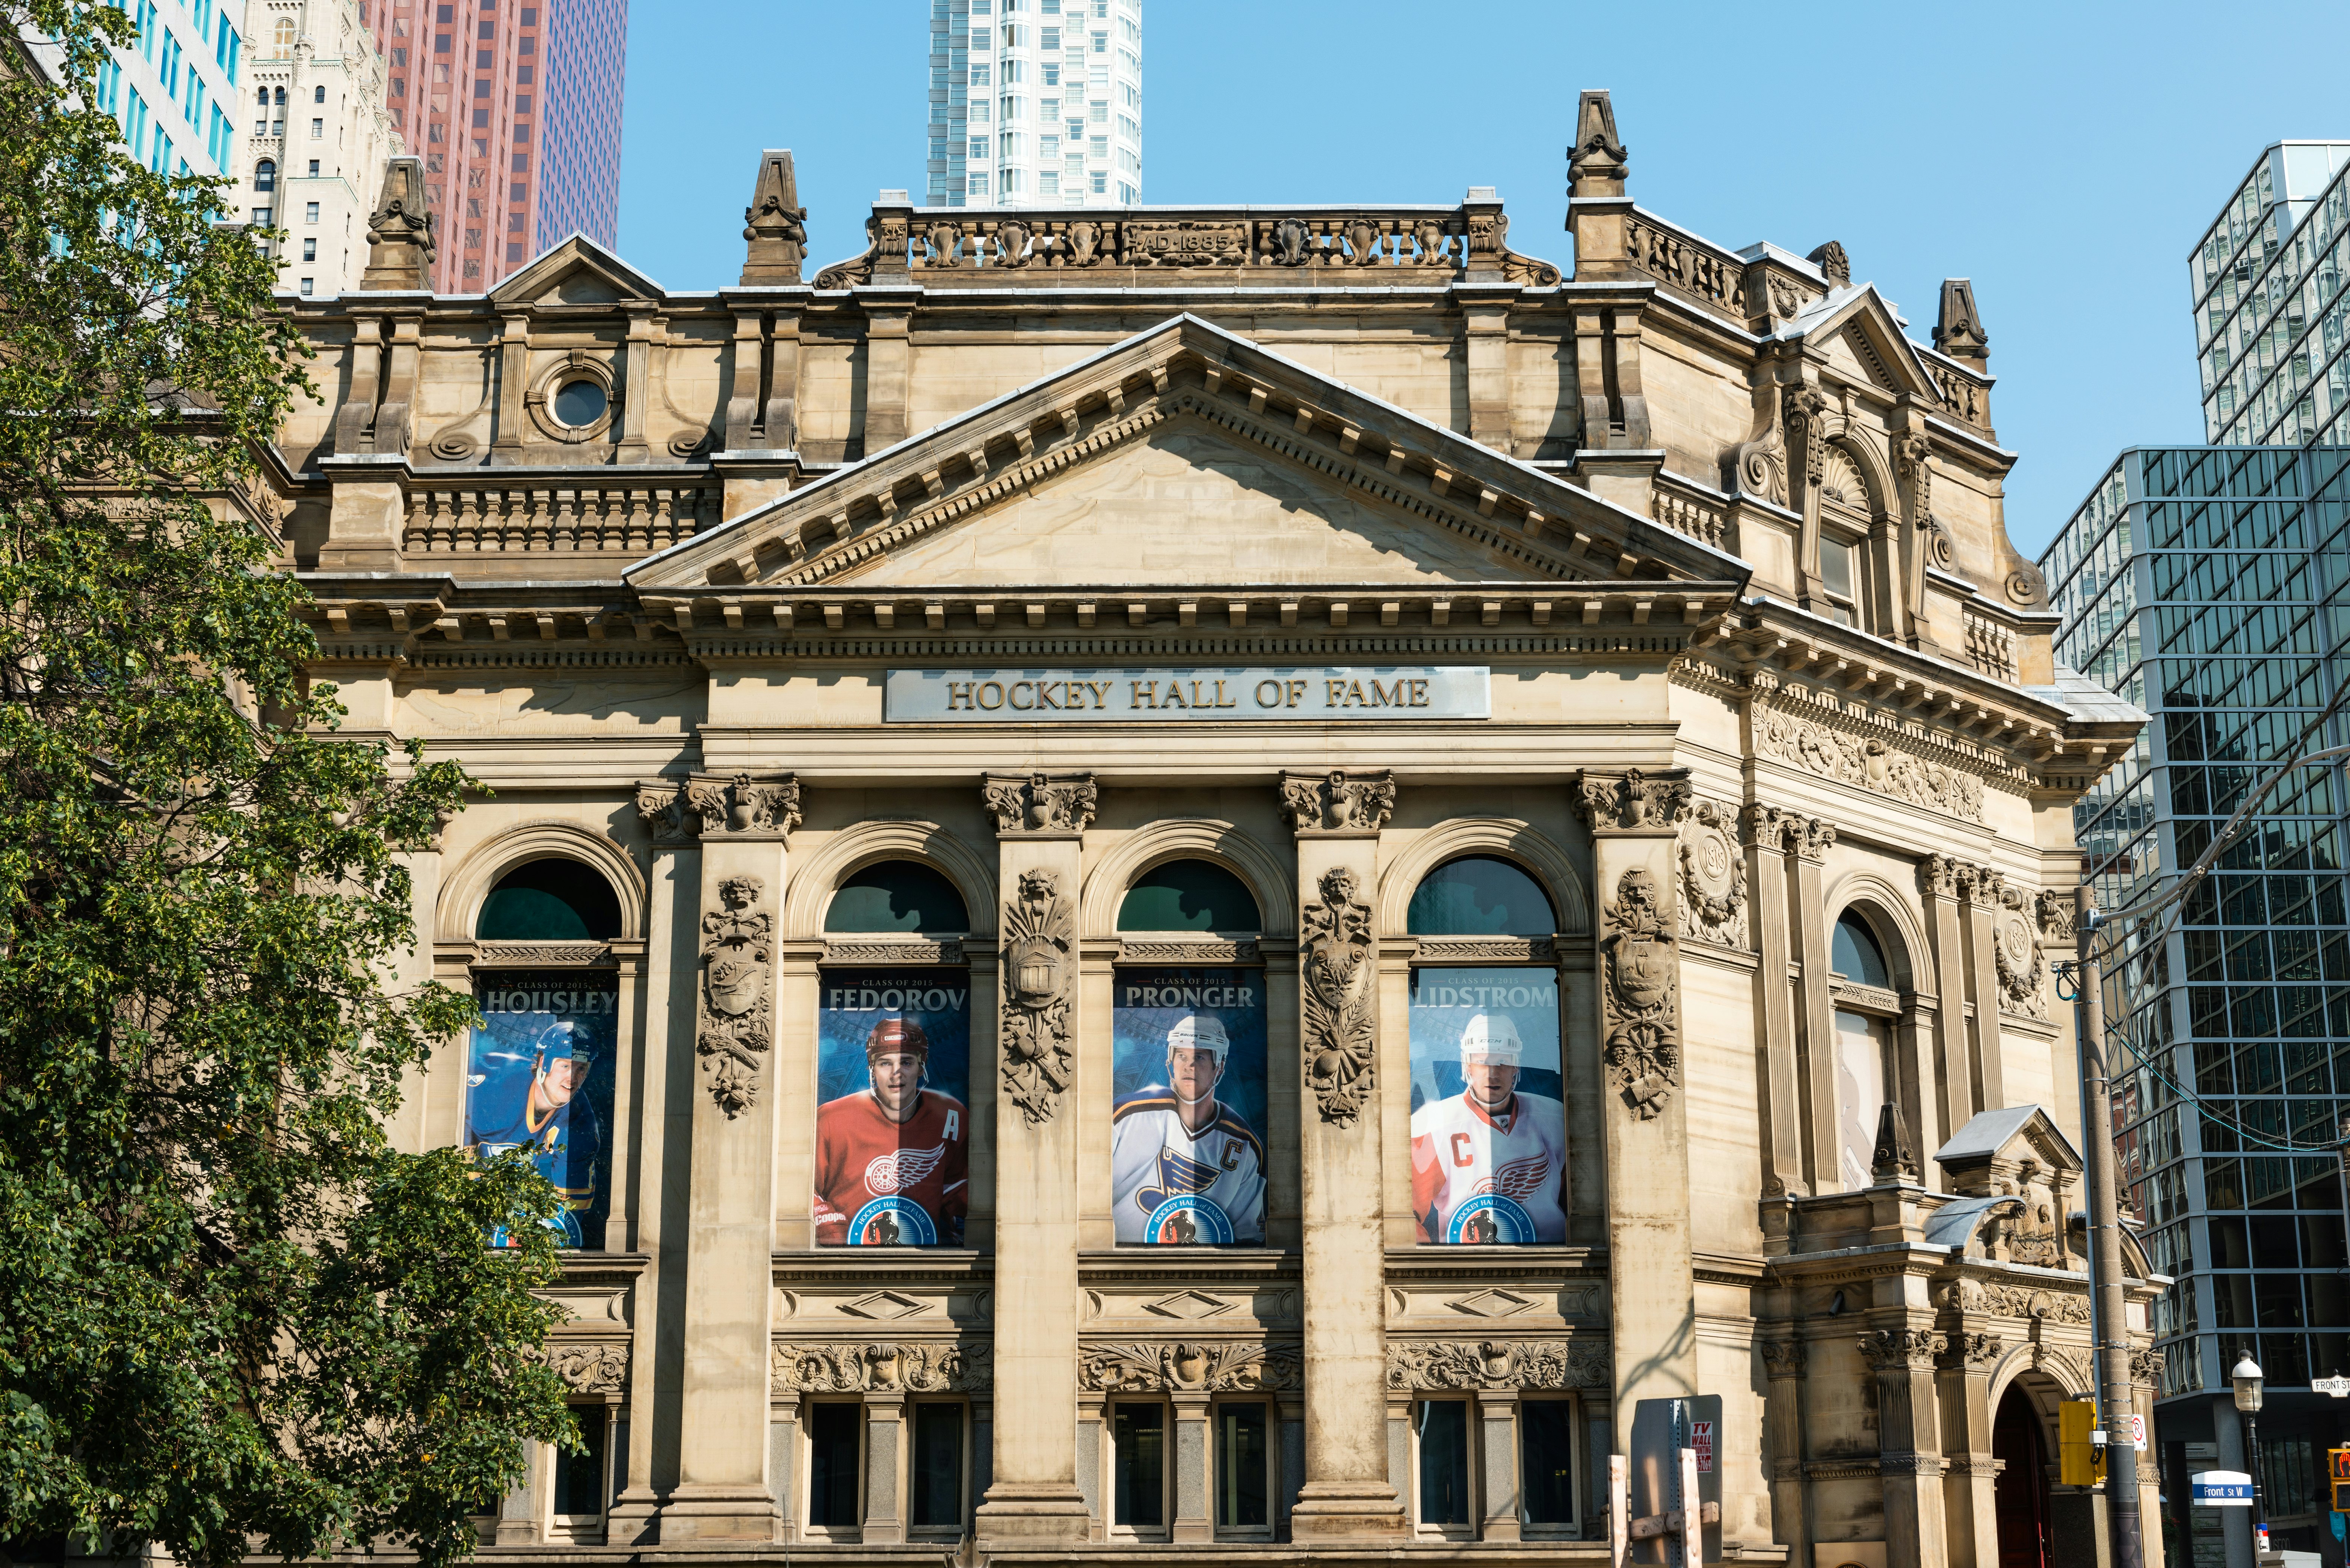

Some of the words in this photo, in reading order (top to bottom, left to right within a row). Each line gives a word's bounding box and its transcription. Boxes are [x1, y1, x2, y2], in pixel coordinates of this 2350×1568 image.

[1181, 234, 1230, 250] 1885
[948, 681, 1113, 709] HOCKEY
[1130, 680, 1236, 708] HALL
[1257, 679, 1308, 708] OF
[1325, 679, 1430, 707] FAME
[486, 992, 618, 1014] HOUSLEY
[829, 989, 967, 1011] FEDOROV
[1126, 987, 1255, 1007] PRONGER
[1414, 987, 1555, 1008] LIDSTROM
[942, 1109, 959, 1141] A
[1220, 1138, 1244, 1172] C
[1450, 1132, 1473, 1168] C
[557, 1210, 573, 1227] FAME
[858, 1203, 882, 1225] HOCKEY
[911, 1207, 927, 1225] FAME
[1154, 1202, 1178, 1224] HOCKEY
[1207, 1206, 1223, 1224] FAME
[1456, 1201, 1479, 1224] HOCKEY
[1508, 1206, 1525, 1223] FAME
[2316, 1381, 2339, 1390] FRONT
[2342, 1381, 2350, 1389] ST
[1694, 1423, 1711, 1434] TV
[1692, 1435, 1711, 1446] WALL
[2204, 1487, 2224, 1496] Front
[2228, 1488, 2234, 1496] St
[2236, 1487, 2243, 1496] W
